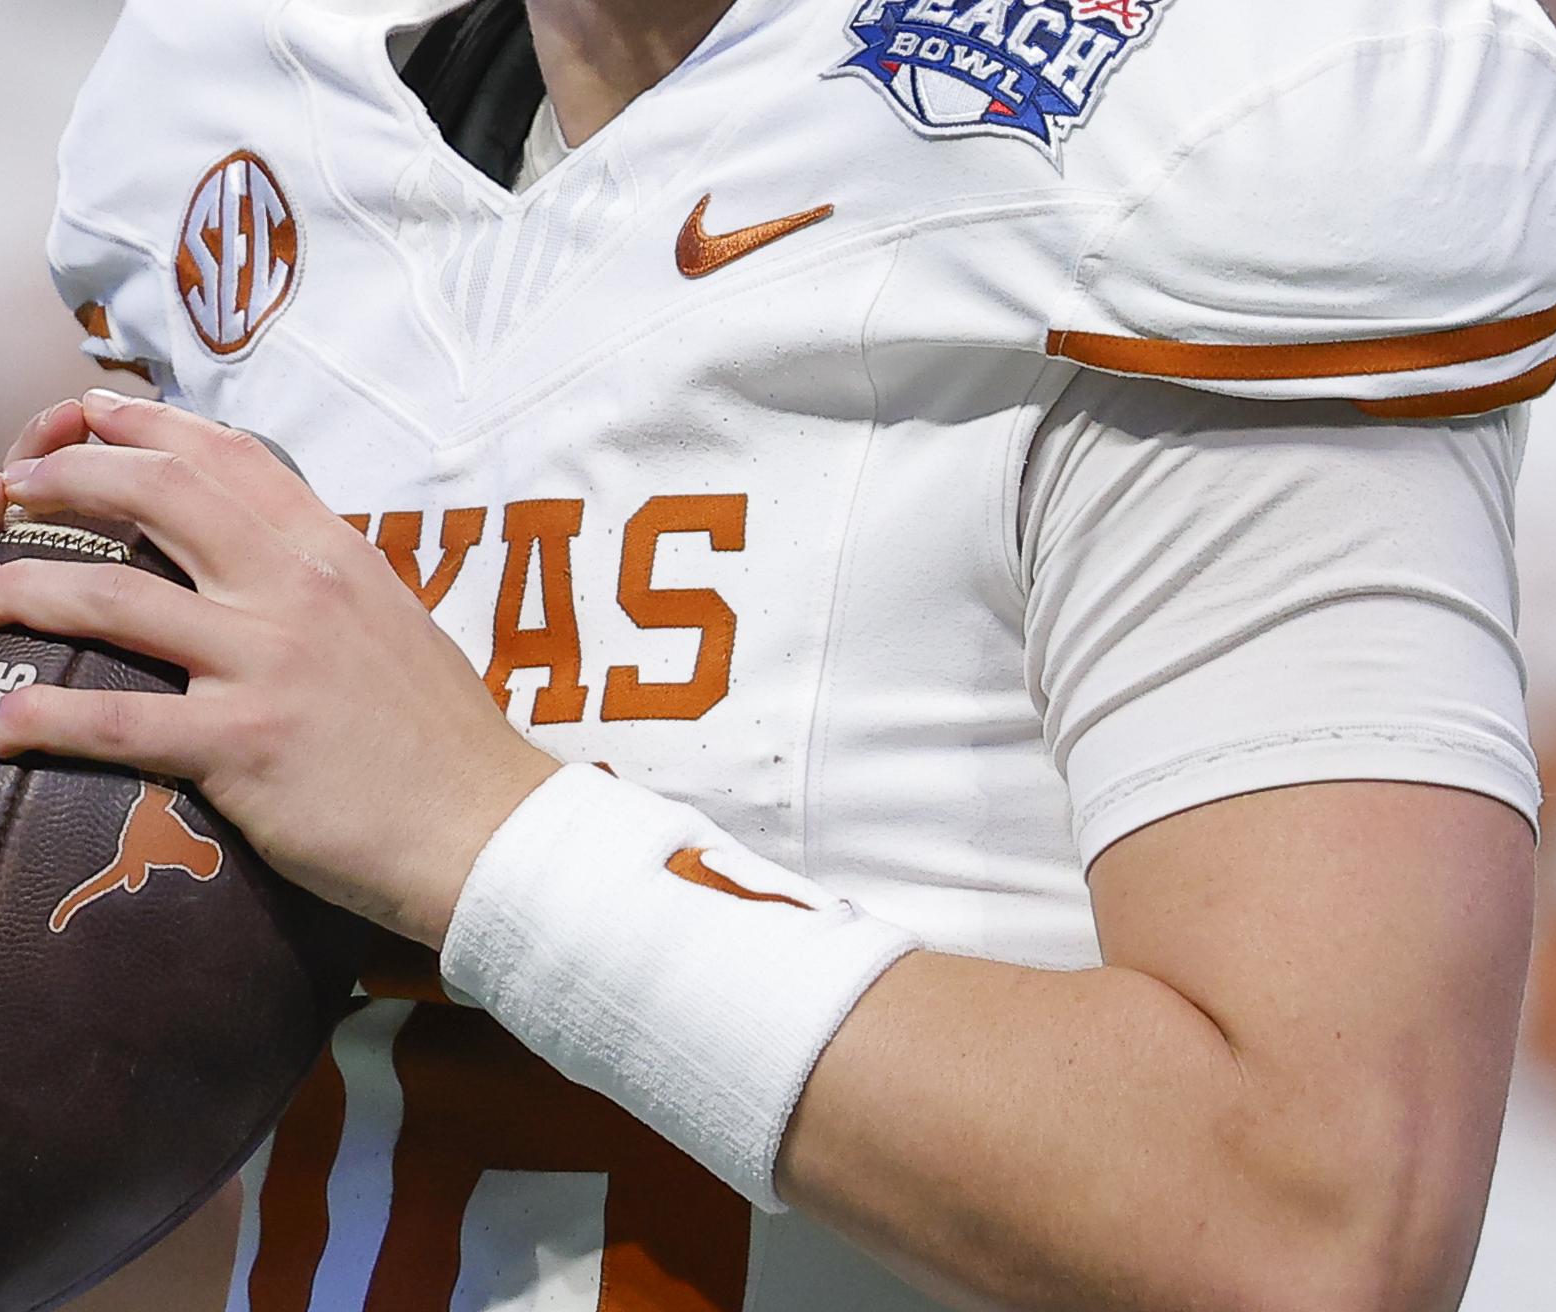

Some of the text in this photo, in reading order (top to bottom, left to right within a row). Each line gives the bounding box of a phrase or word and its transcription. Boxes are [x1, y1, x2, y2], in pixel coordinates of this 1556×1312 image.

[887, 31, 1026, 104] BOWL
[185, 159, 289, 345] SEC
[338, 494, 747, 725] XAS
